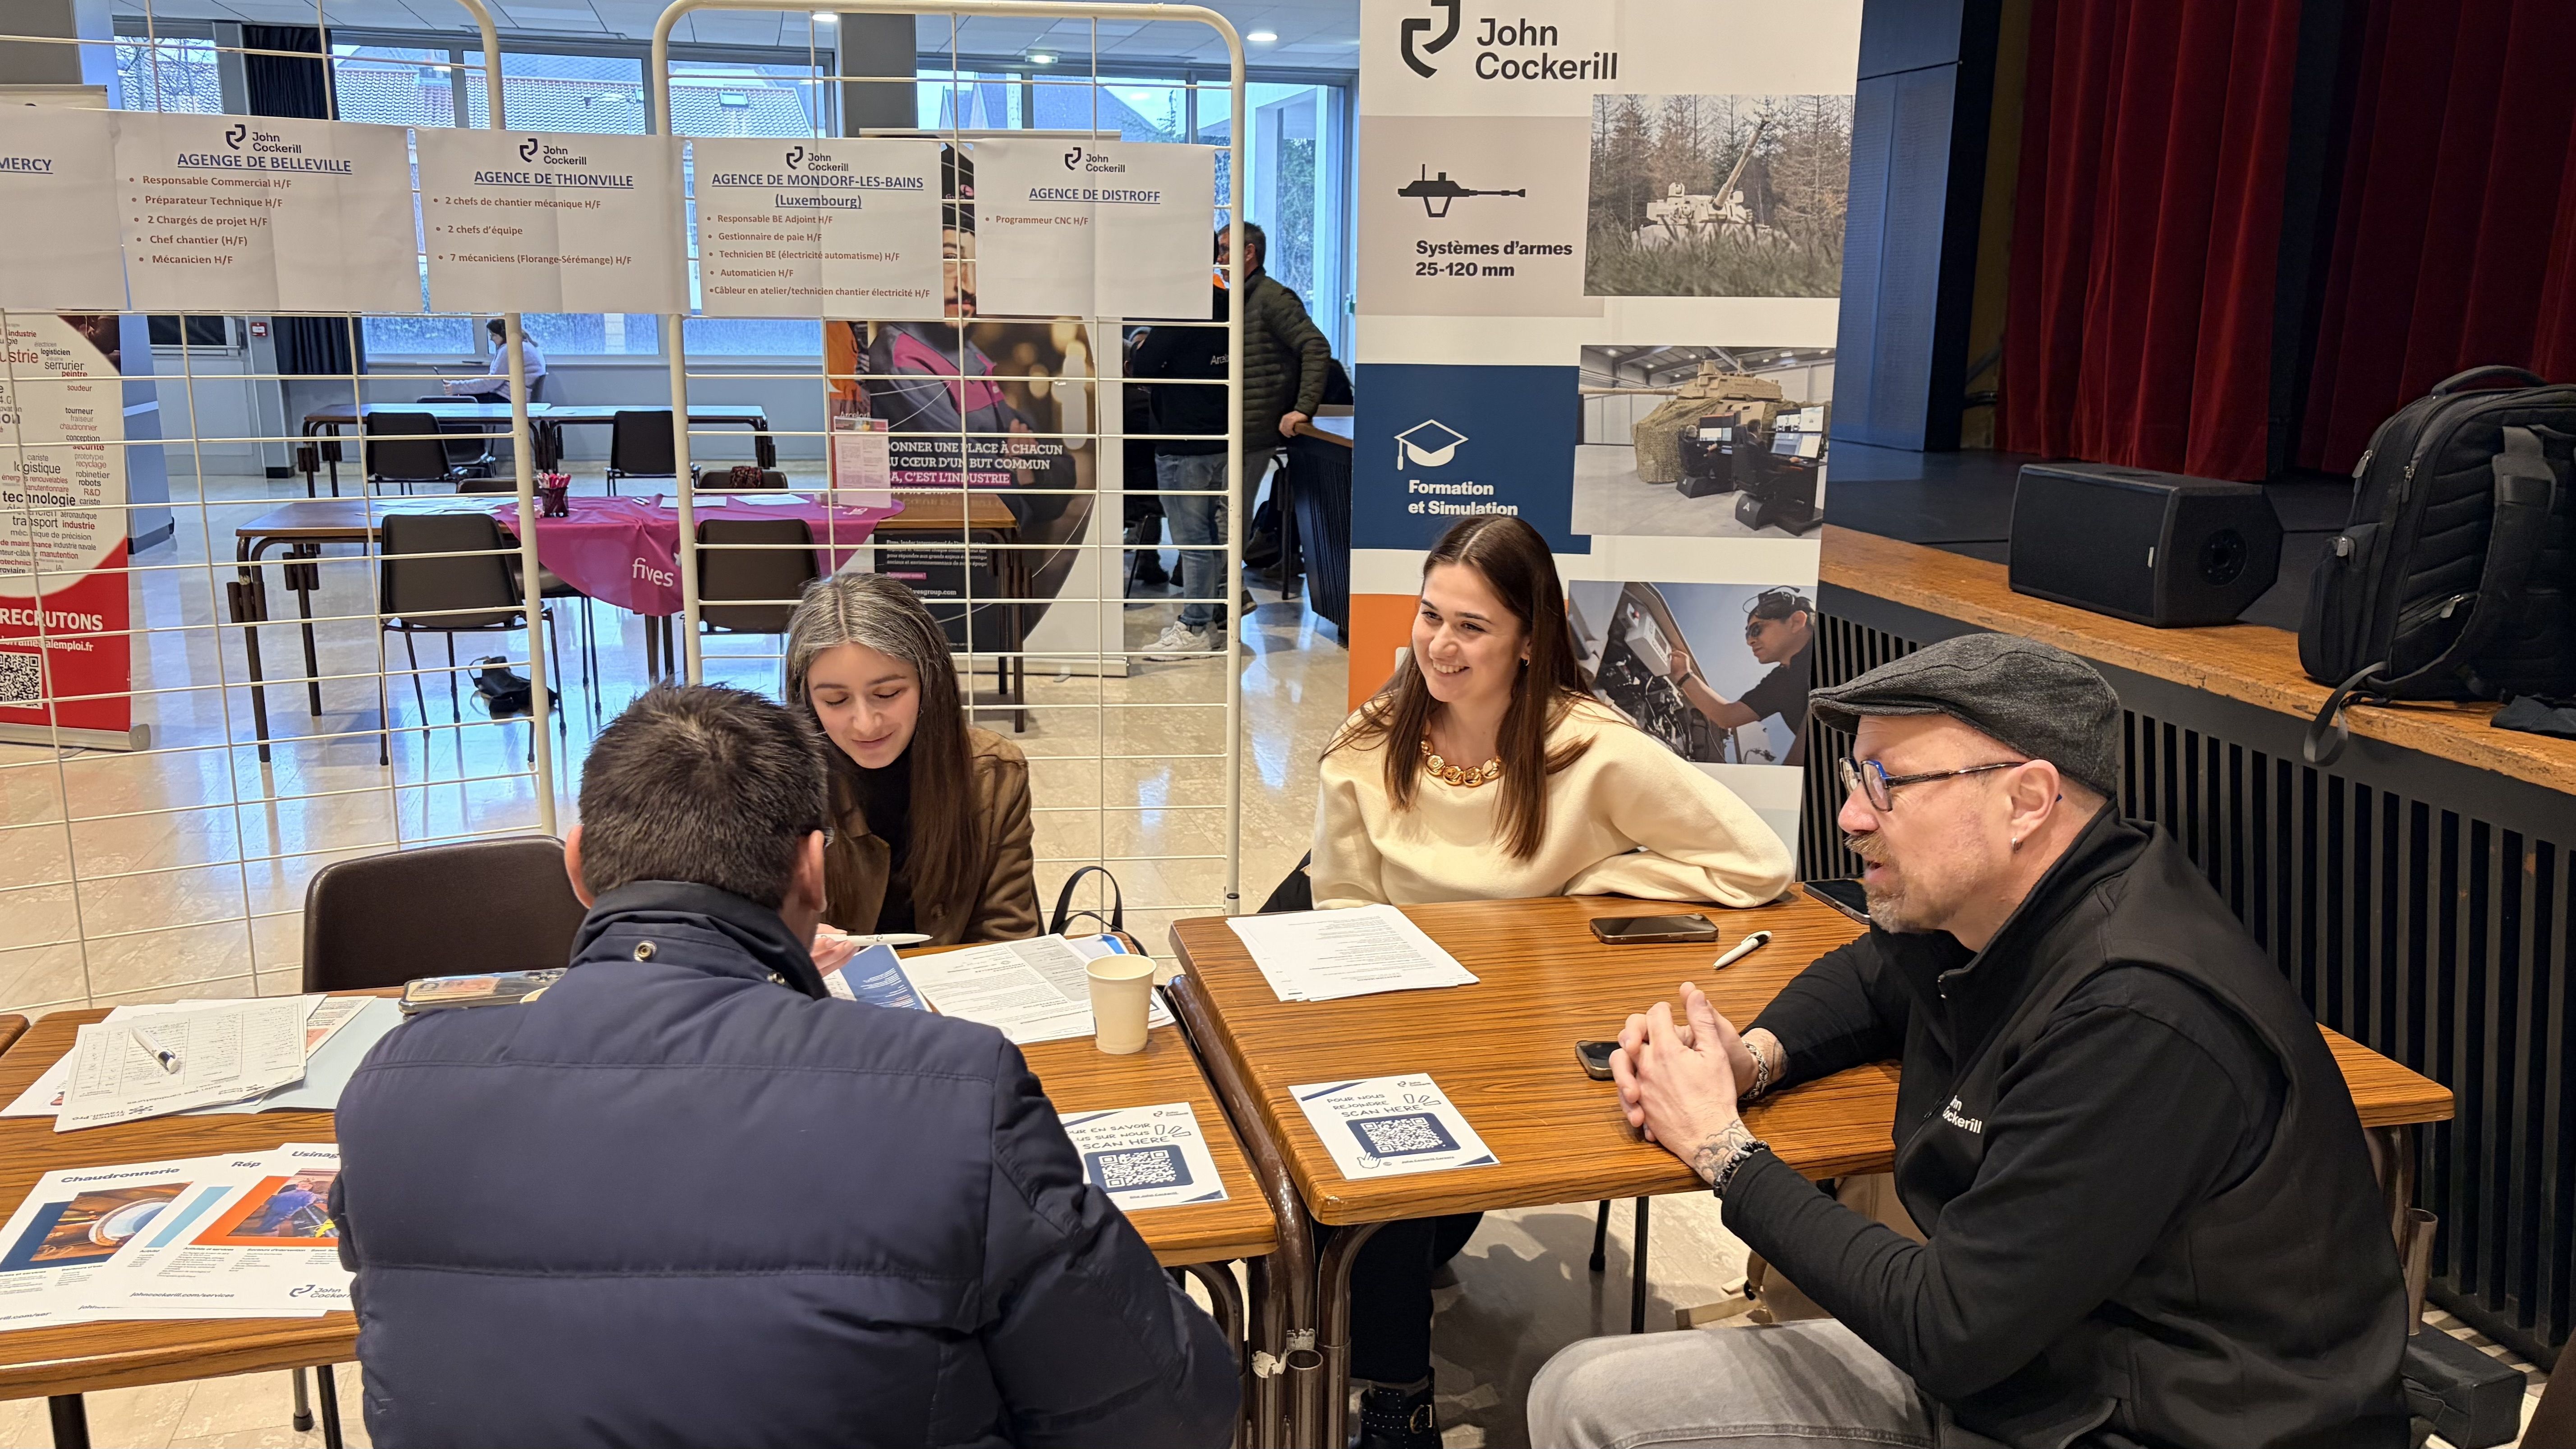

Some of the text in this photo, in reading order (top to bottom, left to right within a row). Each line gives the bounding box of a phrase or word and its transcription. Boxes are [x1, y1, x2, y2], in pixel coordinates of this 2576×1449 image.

[1477, 18, 1558, 46] John
[1475, 51, 1618, 80] Cockerill
[252, 132, 280, 143] John
[253, 143, 302, 154] Cockerill
[543, 146, 568, 155] John
[178, 153, 351, 172] AGENGE DE BELLEVILLE
[543, 156, 587, 165] Cockerill
[808, 153, 831, 161] John
[1086, 154, 1109, 162] John
[808, 163, 848, 171] Cockerill
[1086, 164, 1125, 173] Cockerill
[143, 176, 291, 189] Responsable Commercial H/F
[474, 171, 633, 186] AGENCE DE THIONVILLE
[712, 174, 923, 188] AGENCE DE MONDORF-LES-BAINS
[146, 194, 283, 208] Préparateur Technique H/F
[776, 194, 862, 208] (Luxembourg)
[1029, 188, 1160, 202] AGENCE DE DISTROFF
[454, 197, 478, 206] chefs
[480, 198, 492, 206] de
[494, 198, 532, 207] chantier
[535, 199, 582, 209] mécanique
[585, 201, 601, 209] H/F
[147, 215, 267, 228] 2 Chargés de projet H/F
[718, 215, 771, 224] Responsable
[785, 216, 816, 225] Adjoint
[818, 216, 833, 225] H/F
[996, 216, 1052, 225] Programmeur
[1073, 217, 1088, 226] H/F
[483, 226, 523, 236] d'équipe
[150, 235, 248, 247] Chef chantier (H/F)
[719, 233, 771, 241] Gestionnaire
[787, 234, 804, 243] paie
[807, 234, 822, 242] H/F
[1416, 240, 1573, 258] Systèmes d'armes
[152, 254, 233, 266] Mécanicien H/F
[459, 254, 515, 263] mécaniciens
[517, 254, 613, 266] (Florange-Sérémange)
[616, 256, 632, 266] H/F
[719, 250, 763, 258] Technicien
[778, 251, 823, 261] (électricité
[824, 252, 883, 262] automatisme)
[885, 253, 900, 261] H/F
[721, 269, 794, 278] Automaticien H/F
[1416, 262, 1514, 277] 25-120 mm
[714, 286, 746, 294] Câbleur
[760, 287, 833, 296] atelier/technicien
[835, 287, 870, 296] chantier
[872, 288, 912, 297] électricité
[915, 289, 930, 298] H/F
[45, 360, 84, 370] serrurier
[889, 442, 932, 452] ONNER
[934, 442, 958, 452] UNE
[1000, 441, 1009, 453] À
[1012, 445, 1063, 455] CHACUN
[901, 457, 937, 467] CŒUR
[970, 459, 993, 468] BUT
[994, 459, 1050, 469] COMMUN
[891, 472, 902, 483] A,
[905, 472, 937, 482] C'EST
[1408, 479, 1494, 496] Formation
[1408, 500, 1518, 516] et Simulation
[62, 520, 95, 529] industrie
[62, 533, 92, 541] précision
[40, 551, 78, 559] manutention
[632, 557, 674, 587] fives
[0, 608, 103, 631] RECRUTONS
[1333, 1101, 1389, 1109] REJOINDRE
[1083, 1136, 1170, 1149] SCAN HERE
[231, 1161, 262, 1169] Rép
[61, 1168, 180, 1183] Chaudronnerie
